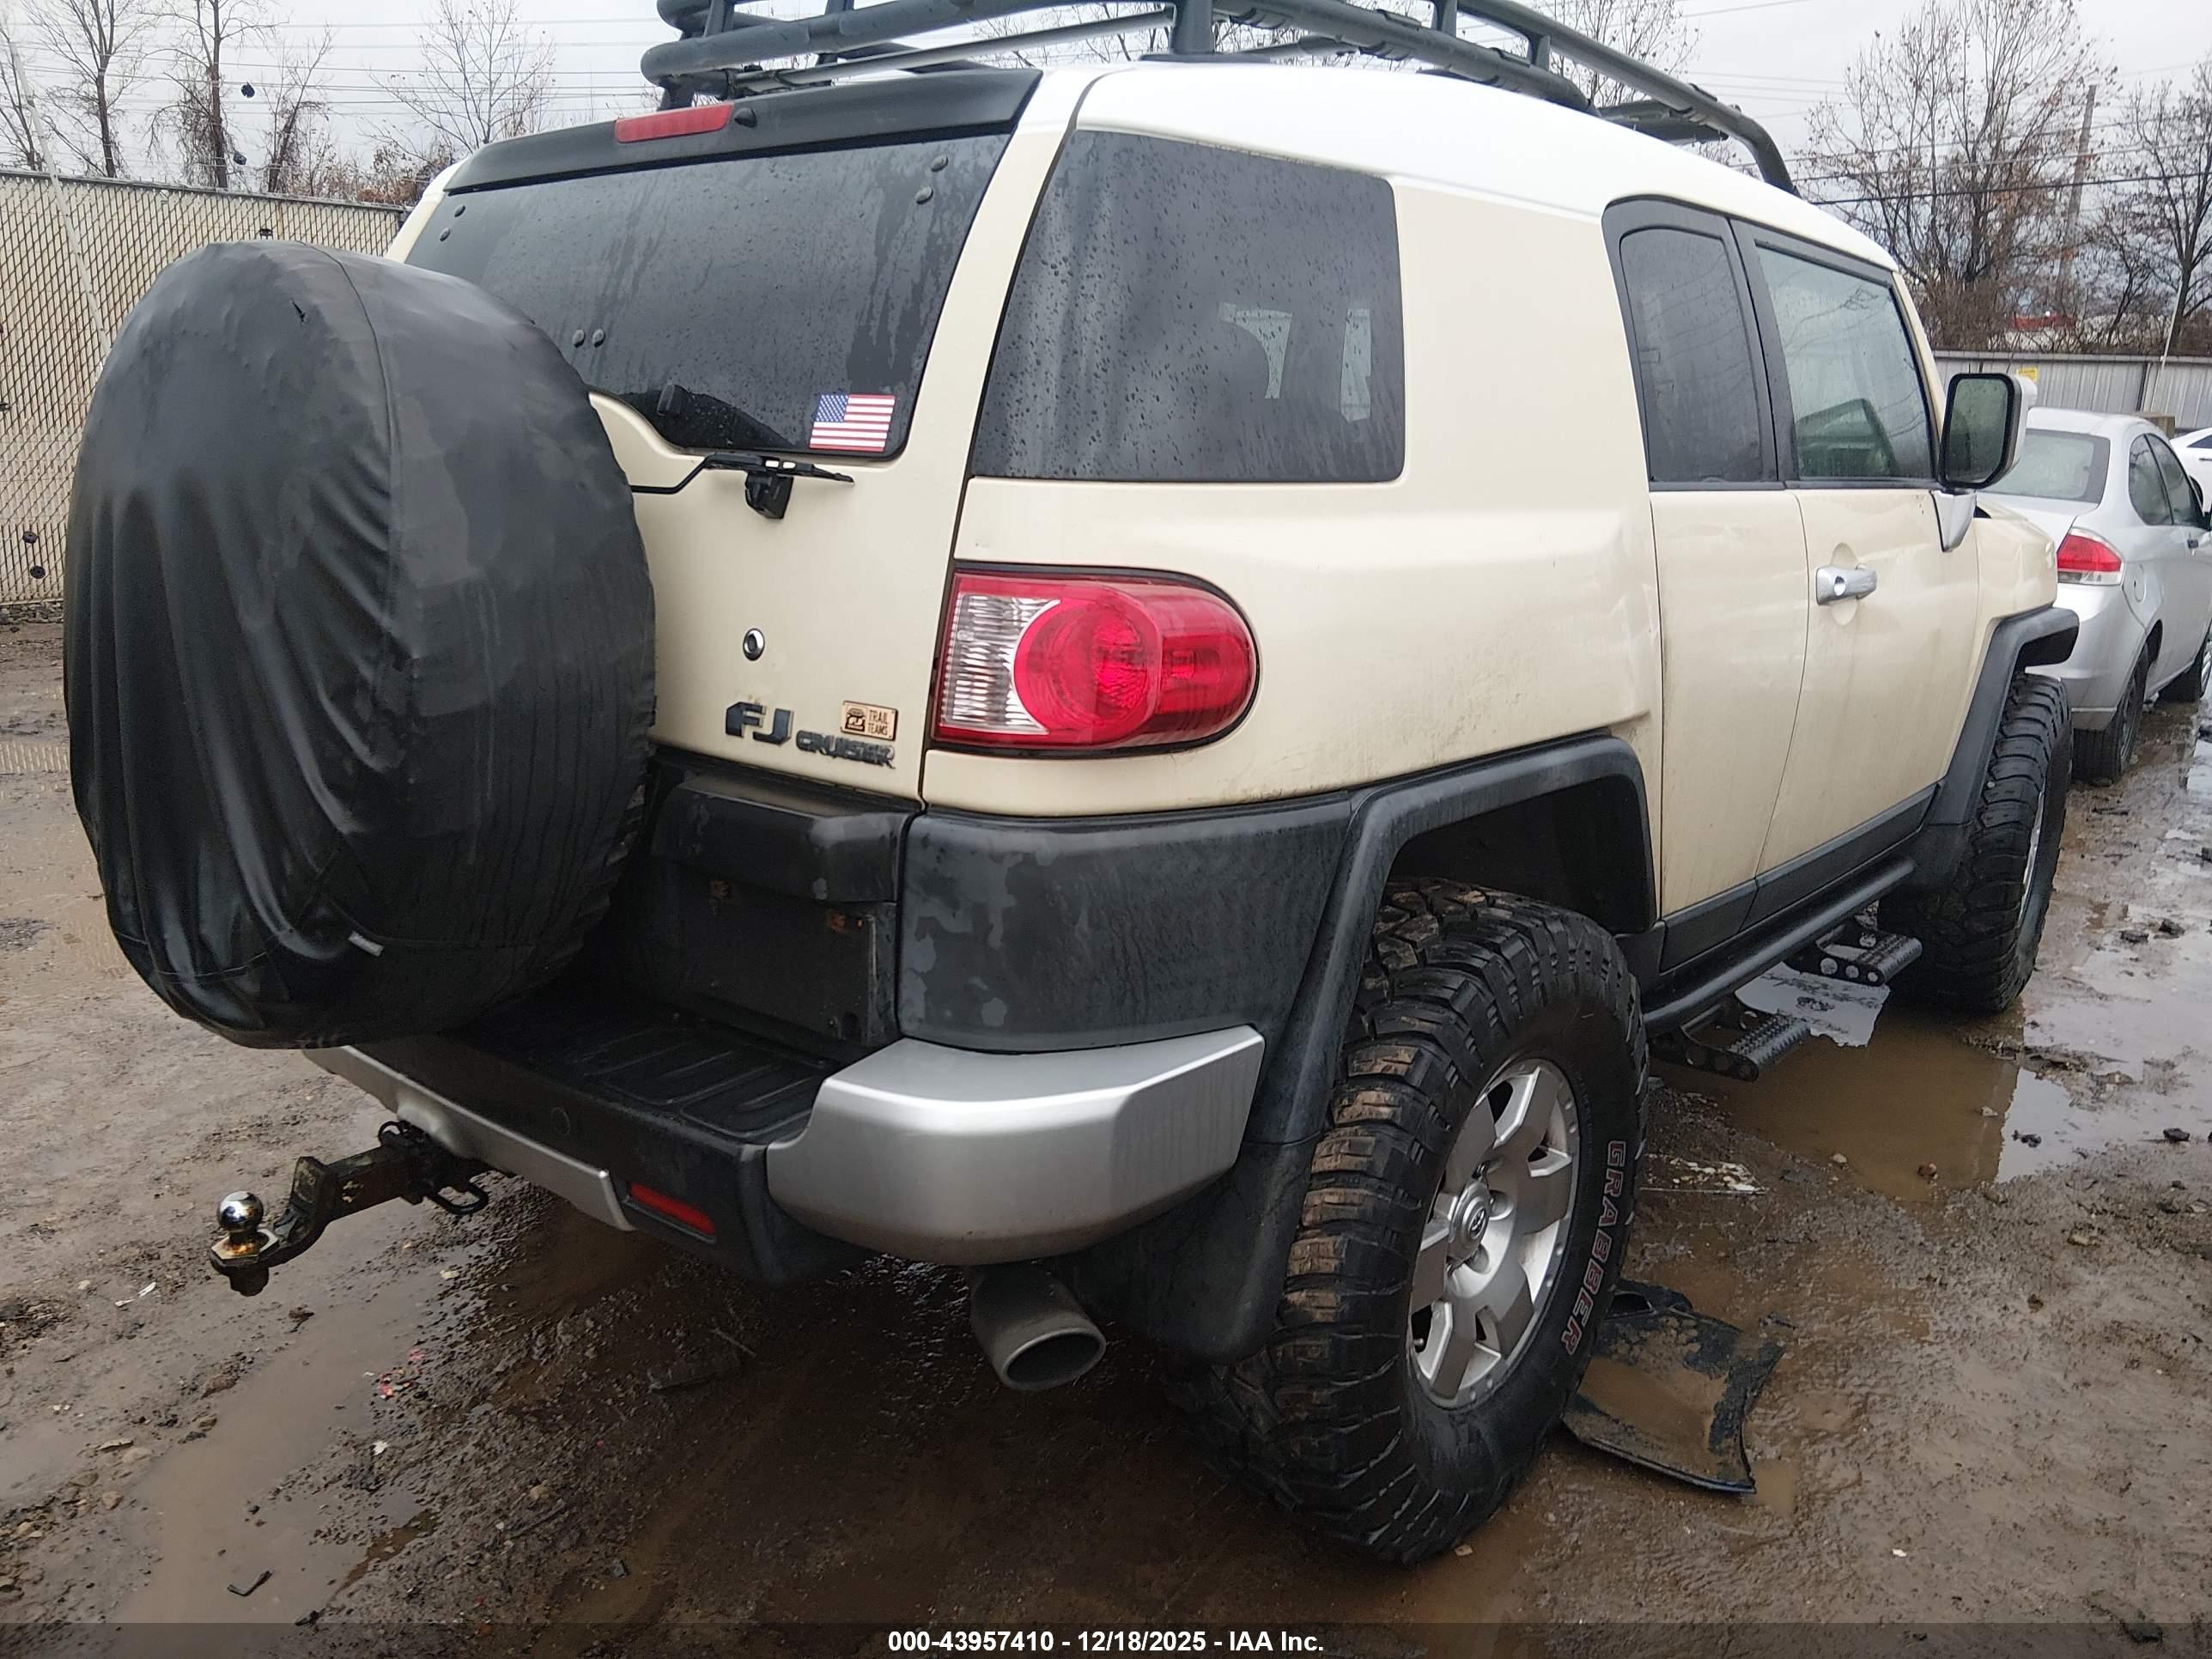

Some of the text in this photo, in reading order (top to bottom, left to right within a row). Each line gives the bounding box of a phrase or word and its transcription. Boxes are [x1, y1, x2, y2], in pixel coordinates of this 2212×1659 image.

[726, 702, 793, 745] FJ
[867, 722, 889, 736] TEAMS
[868, 709, 890, 725] TRAIL
[1561, 1140, 1626, 1355] GRABBER
